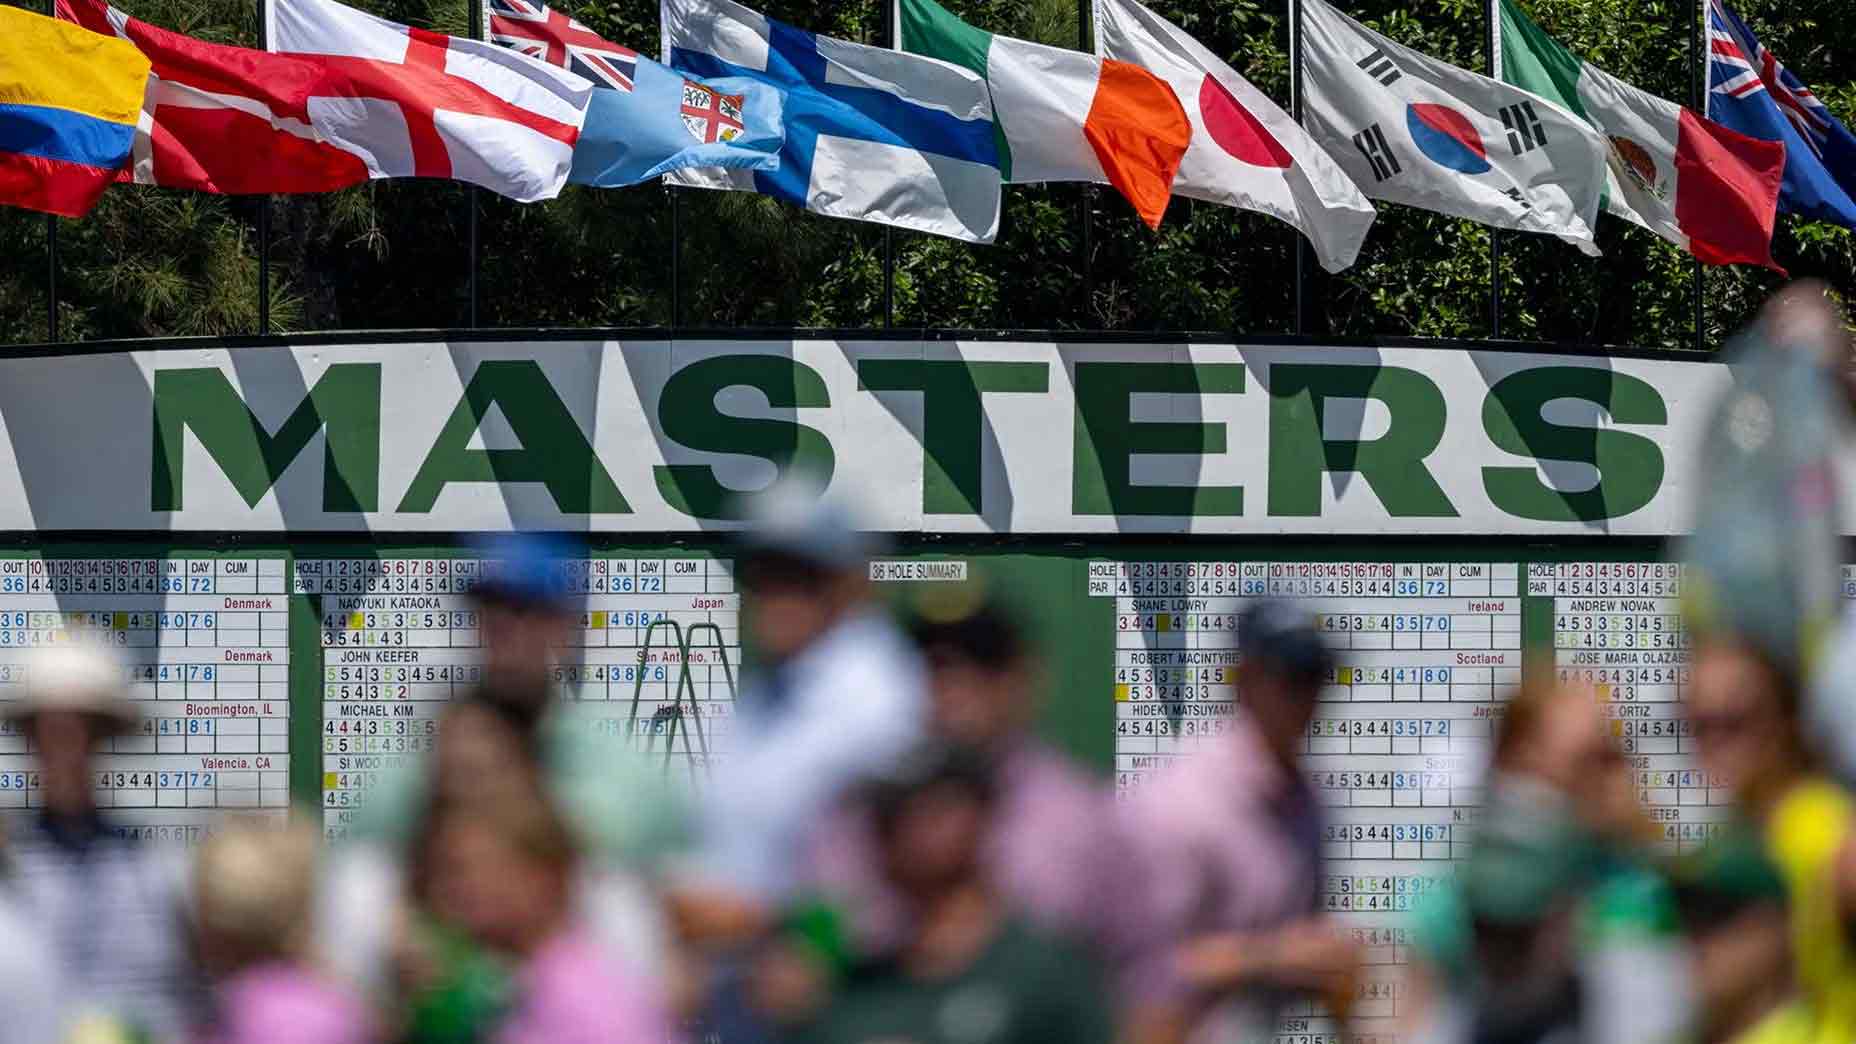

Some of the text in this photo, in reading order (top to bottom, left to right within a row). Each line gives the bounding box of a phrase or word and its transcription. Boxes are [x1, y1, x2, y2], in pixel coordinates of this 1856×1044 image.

[151, 354, 1668, 522] MASTERS
[3, 563, 247, 574] OUT 10 11 12 13 14 15 16 17 18 IN DAY CUM
[296, 563, 321, 574] HOLE
[328, 562, 332, 574] 1
[340, 562, 347, 574] 2
[354, 562, 361, 574] 3
[368, 562, 376, 574] 4
[383, 562, 390, 574] 5
[396, 562, 404, 574] 6
[411, 562, 419, 574] 7
[426, 562, 433, 574] 8
[439, 562, 447, 574] 9
[456, 563, 475, 573] OUT
[595, 562, 605, 574] 18
[617, 562, 626, 572] IN
[641, 562, 659, 572] DAY
[675, 562, 696, 572] CUM
[873, 565, 962, 579] 36 HOLE SUMMARY
[1091, 565, 1480, 576] HOLE 1 2 3 4 5 6 7 8 9 OUT 10 11 12 13 14 15 16 17 18 IN DAY CUM
[1530, 566, 1662, 577] HOLE 1 2 3 4 5 6 7 8
[3, 579, 210, 591] 36 36 72
[296, 579, 659, 591] PAR 4 5 4 3 4 3 4 5 4 36 72
[1091, 581, 1445, 593] PAR 36 36 72
[1530, 583, 1546, 592] PAR
[225, 598, 272, 609] Denmark
[339, 598, 440, 608] NAOYUKI KATAOKA
[692, 599, 723, 610] Japan
[1132, 601, 1208, 611] SHANE LOWRY
[1469, 602, 1504, 611] Ireland
[1571, 602, 1655, 611] ANDREW NOVAK
[225, 651, 272, 661] Denmark
[341, 652, 418, 662] JOHN KEEFER
[663, 652, 706, 663] Antnio,
[1132, 654, 1239, 664] ROBERT MACINTYRE
[1457, 654, 1504, 664] Scotland
[1572, 654, 1600, 664] JOSE
[1606, 654, 1638, 664] MARIA
[264, 705, 272, 714] IL
[341, 706, 413, 716] MICHAEL KIM
[1133, 706, 1234, 716] HIDEKI MATSUYAMA
[1620, 706, 1650, 716] ORTIZ
[1640, 723, 1674, 734] 4 5 4
[256, 758, 270, 768] CA
[340, 759, 349, 768] SI
